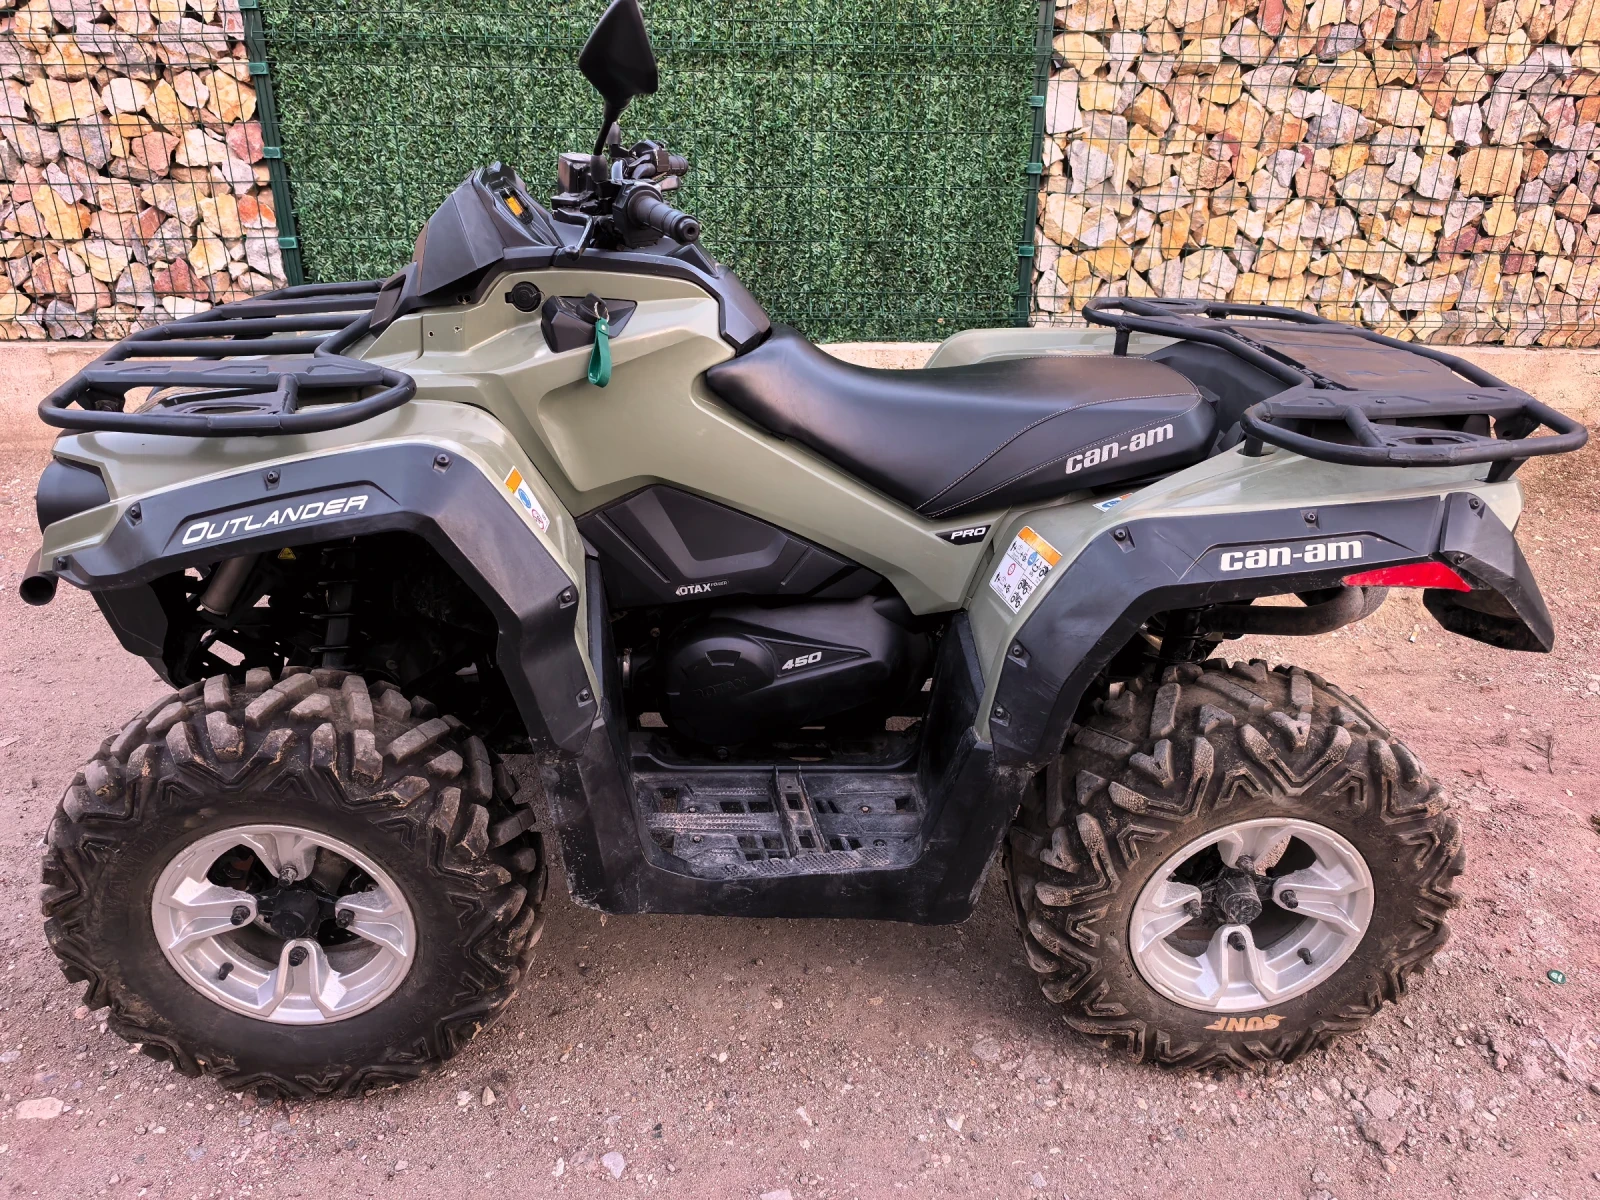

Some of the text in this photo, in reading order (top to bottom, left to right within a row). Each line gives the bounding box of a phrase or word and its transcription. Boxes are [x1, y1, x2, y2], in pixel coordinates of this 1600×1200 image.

[1065, 423, 1174, 475] can-am
[182, 495, 369, 545] OUTLANDER
[950, 526, 986, 540] PRO
[1220, 540, 1363, 571] can-am
[781, 651, 822, 670] 450
[1203, 1013, 1287, 1032] SUNF
